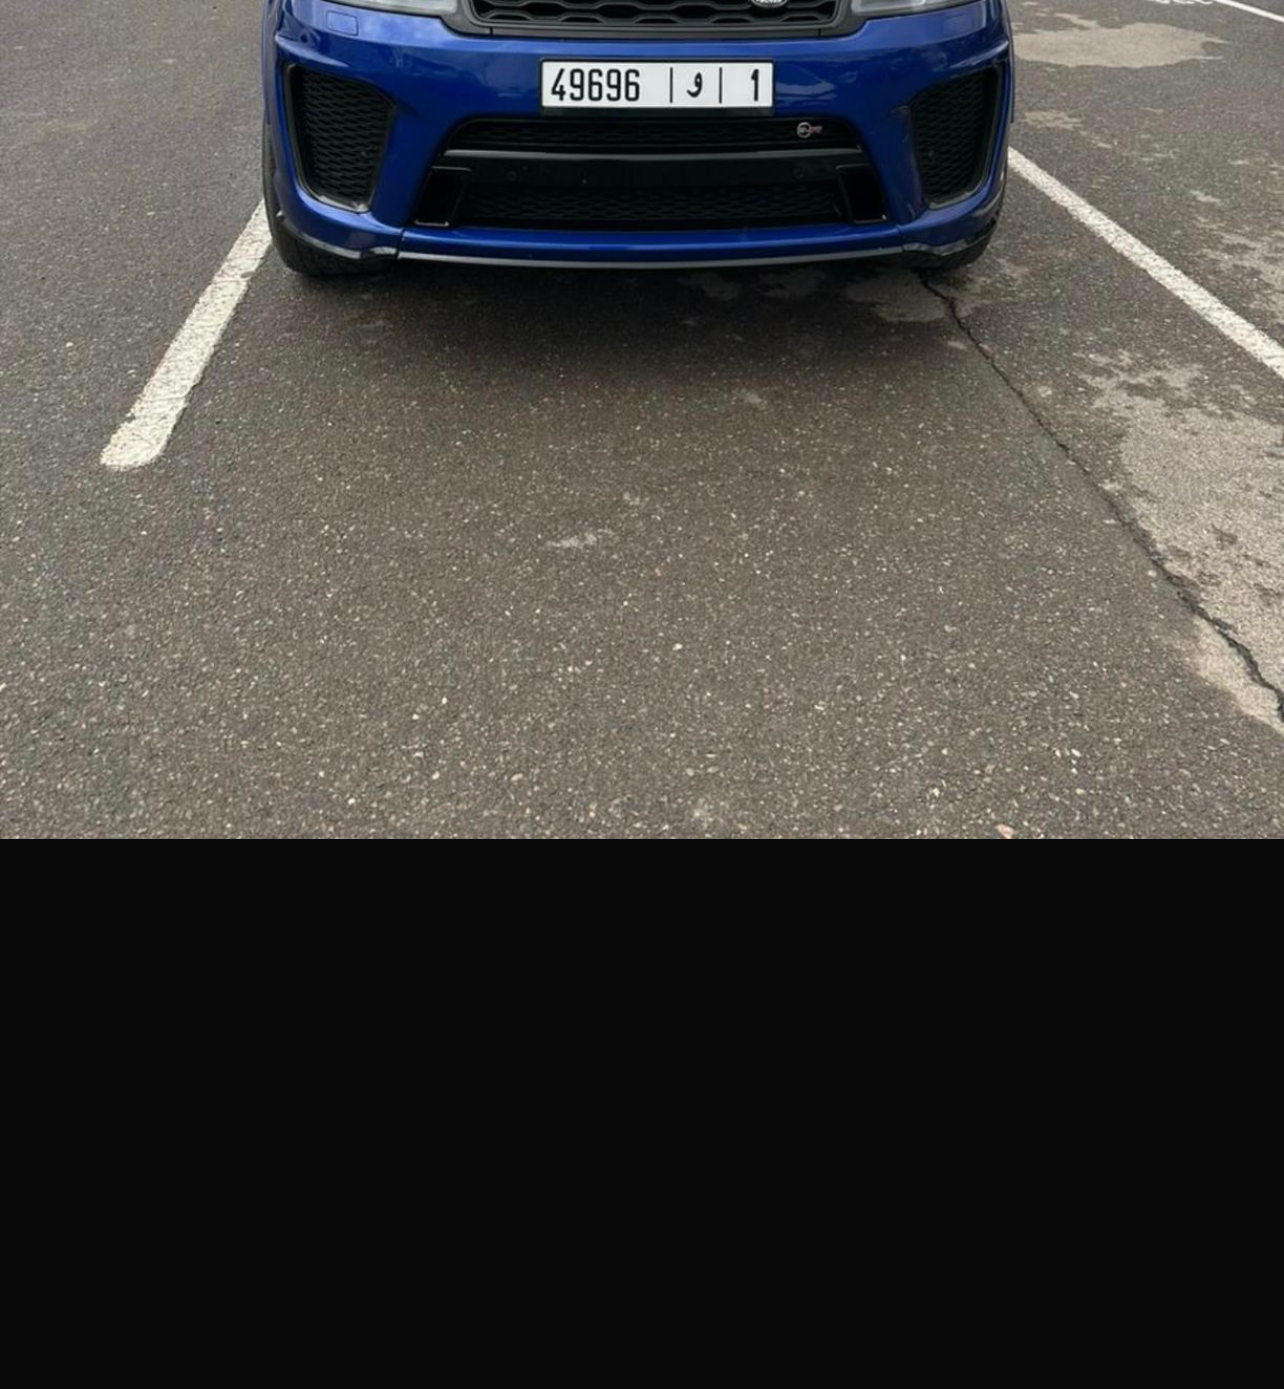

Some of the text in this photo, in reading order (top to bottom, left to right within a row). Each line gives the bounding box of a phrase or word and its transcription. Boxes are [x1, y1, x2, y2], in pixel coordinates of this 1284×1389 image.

[551, 68, 759, 102] 49696 و 1
